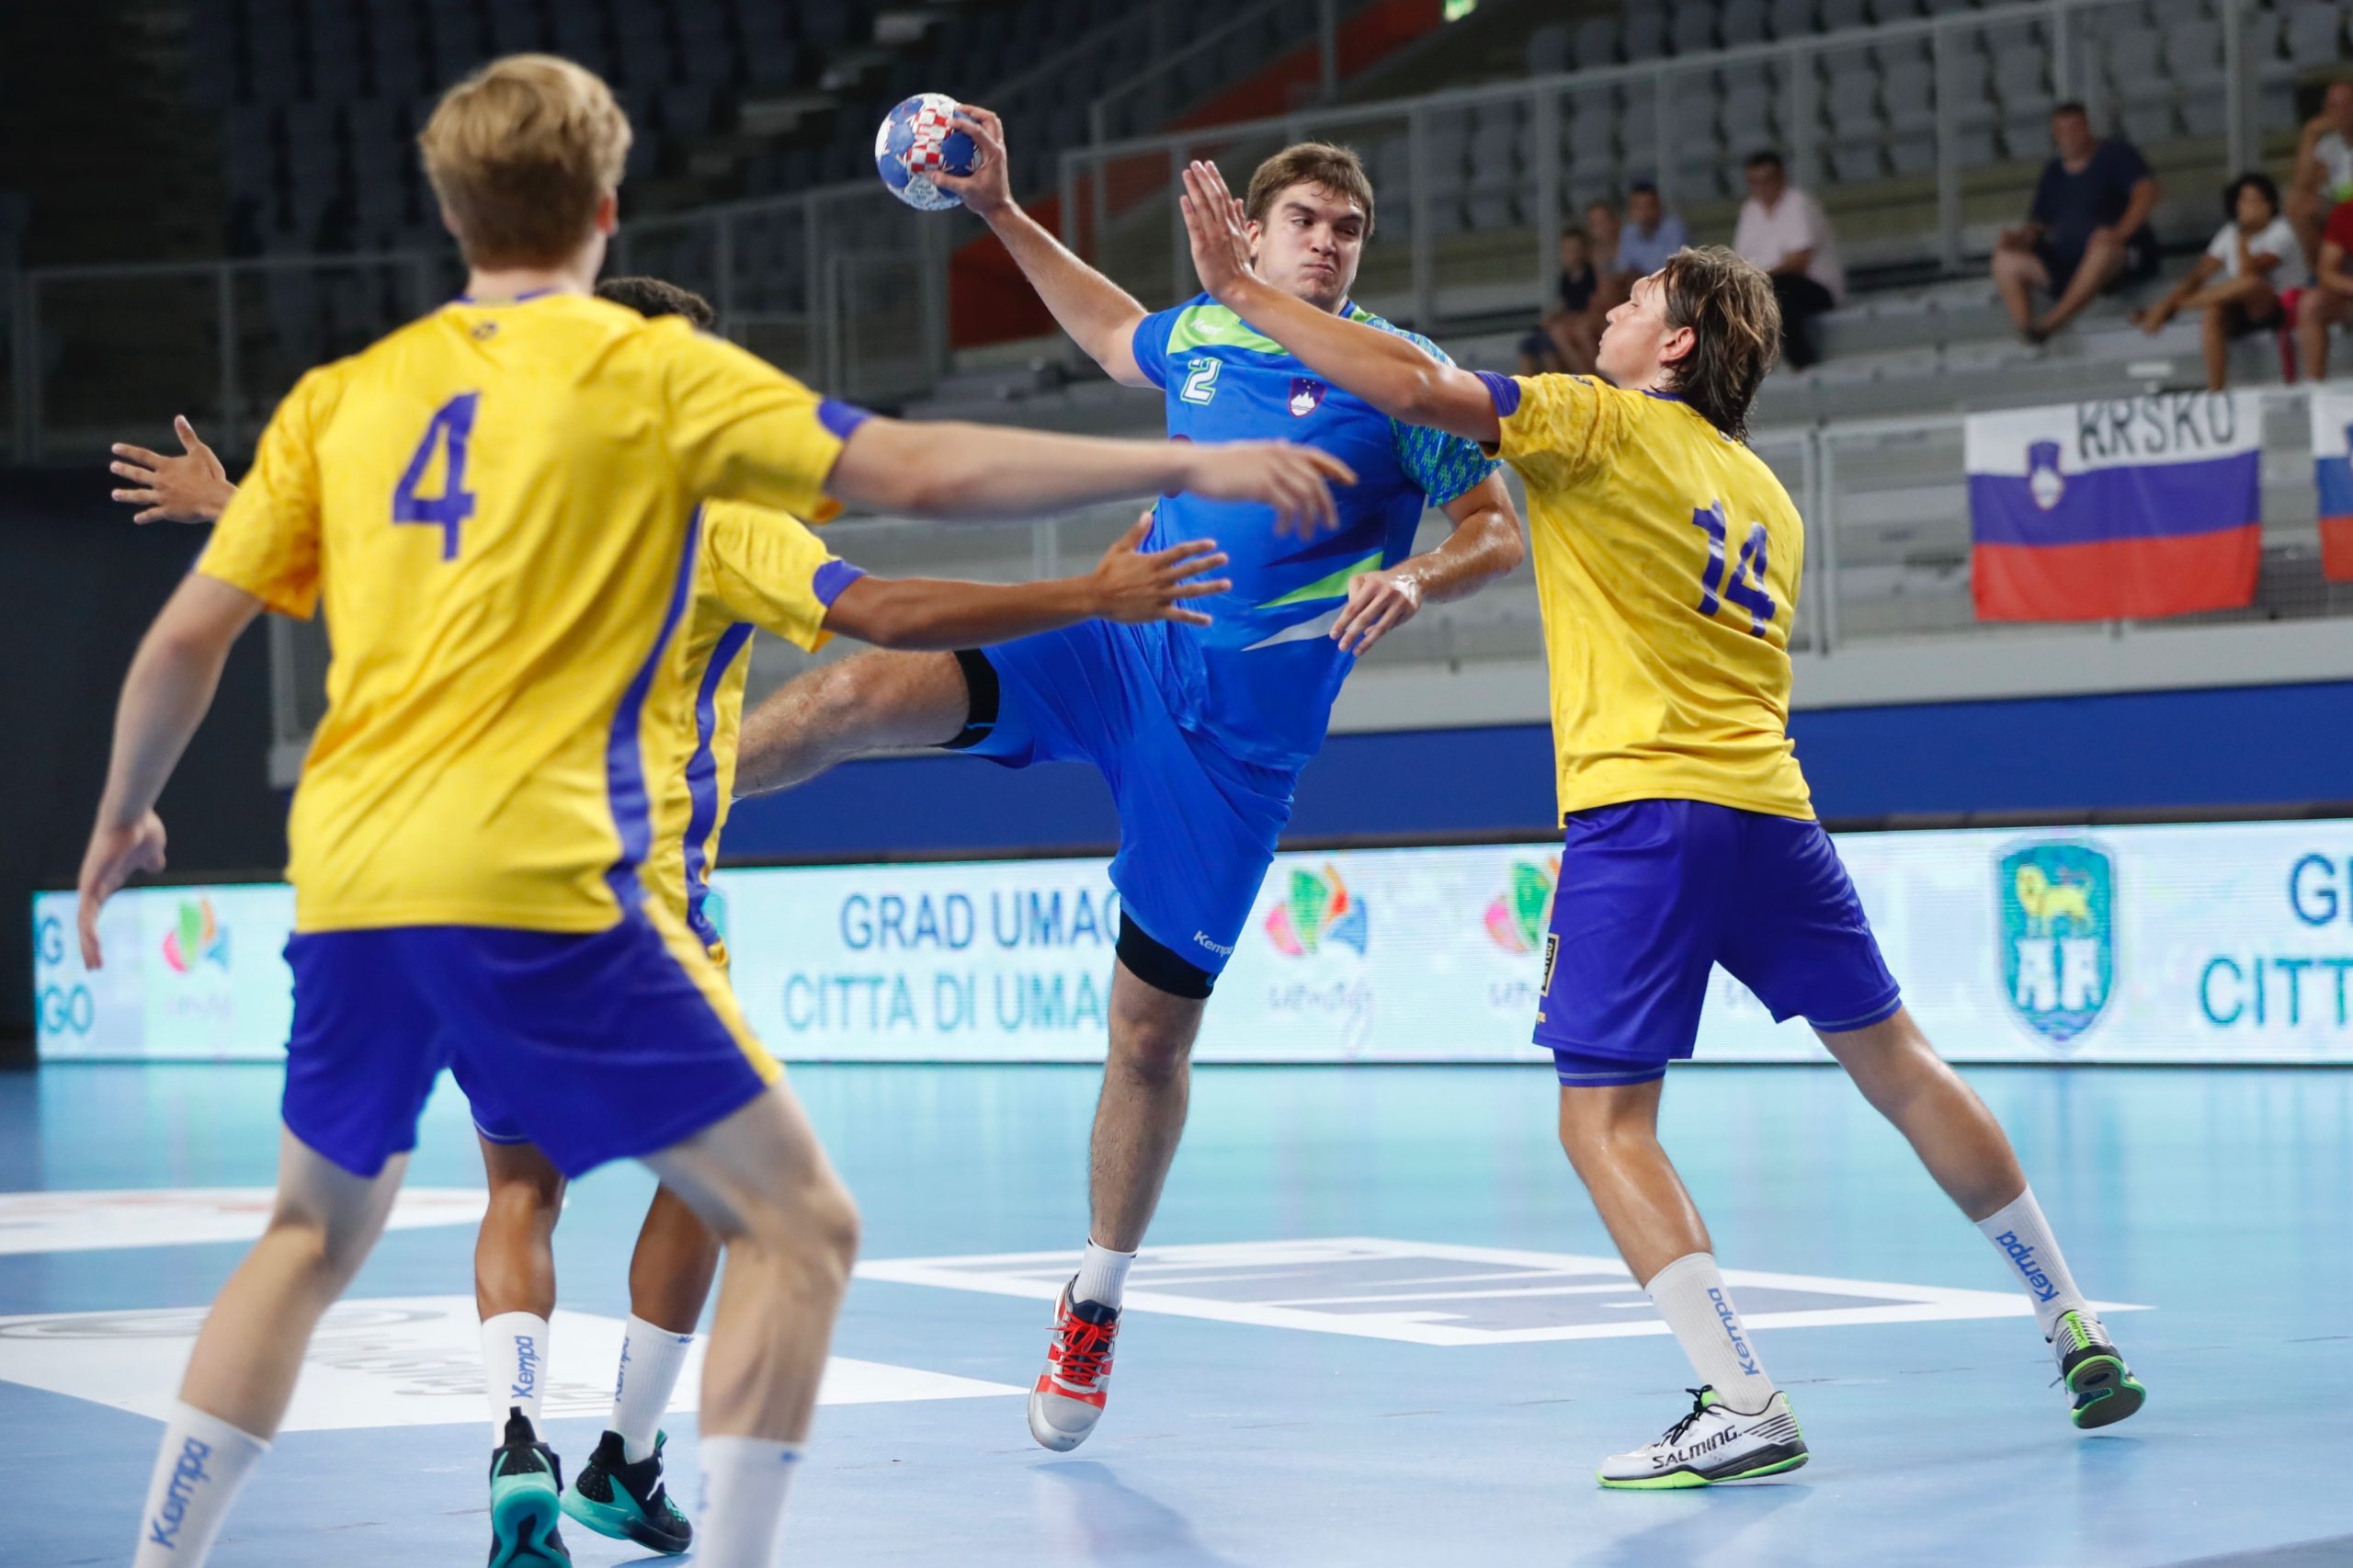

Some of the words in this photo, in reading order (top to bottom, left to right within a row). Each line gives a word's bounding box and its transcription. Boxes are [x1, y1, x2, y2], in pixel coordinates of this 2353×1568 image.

[1180, 356, 1223, 405] 2
[392, 390, 482, 563] 4
[1692, 497, 1776, 638] 14
[838, 893, 976, 950] GRAD
[2289, 852, 2353, 927] G
[783, 973, 917, 1032] CITTA
[933, 973, 977, 1032] DI
[995, 971, 1108, 1032] UMA
[1995, 1231, 2061, 1302] Kempa
[511, 1335, 541, 1399] Kempa
[1707, 1288, 1760, 1376] Kempa
[149, 1437, 213, 1550] Kempa
